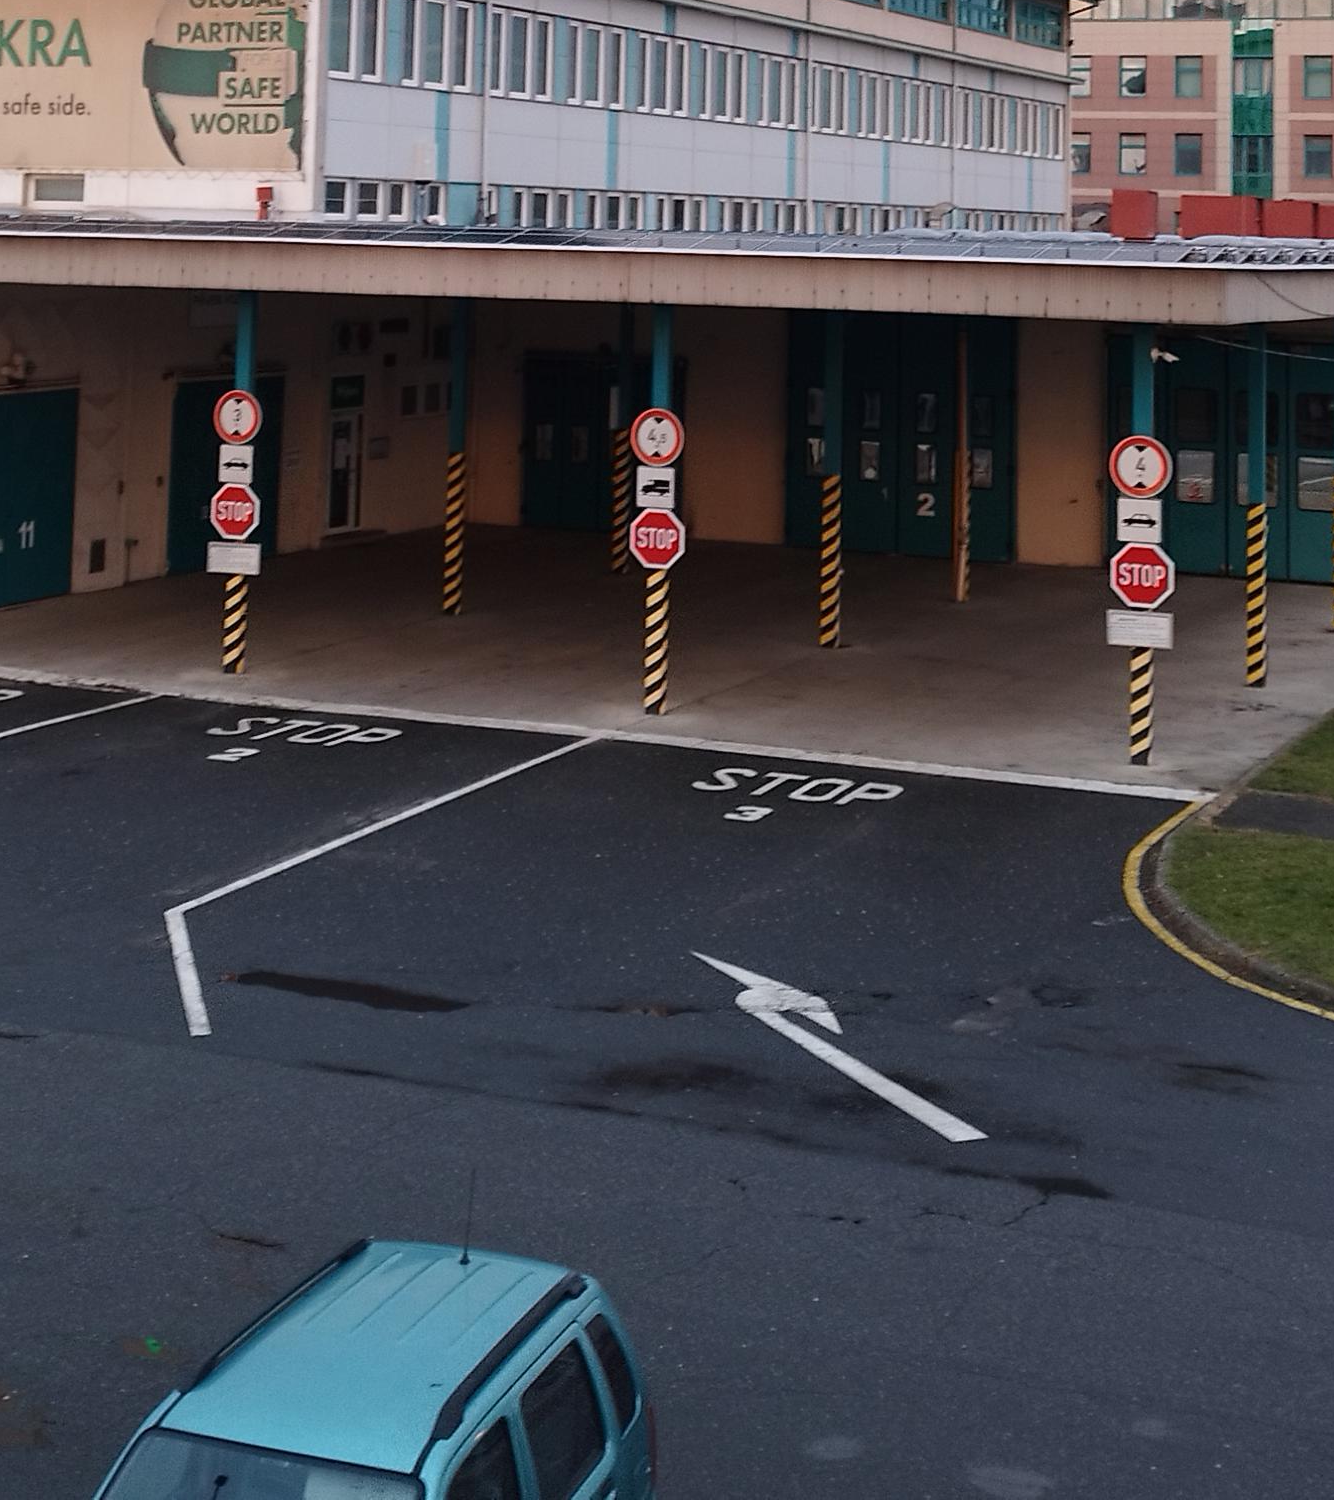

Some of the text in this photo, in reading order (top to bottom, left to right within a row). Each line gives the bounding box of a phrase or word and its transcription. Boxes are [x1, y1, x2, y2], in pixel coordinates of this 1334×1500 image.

[177, 21, 283, 43] PARTNER
[224, 77, 281, 99] SAFE
[3, 93, 41, 115] safe
[47, 93, 91, 115] side.
[190, 112, 281, 135] WORLD
[217, 501, 254, 521] STOP
[917, 494, 935, 517] 2
[18, 520, 35, 549] 11
[636, 527, 678, 550] STOP
[1118, 563, 1166, 587] STOP
[206, 717, 403, 747] STOP
[206, 747, 261, 762] 2
[691, 767, 904, 805] STOP
[723, 805, 774, 822] 3
